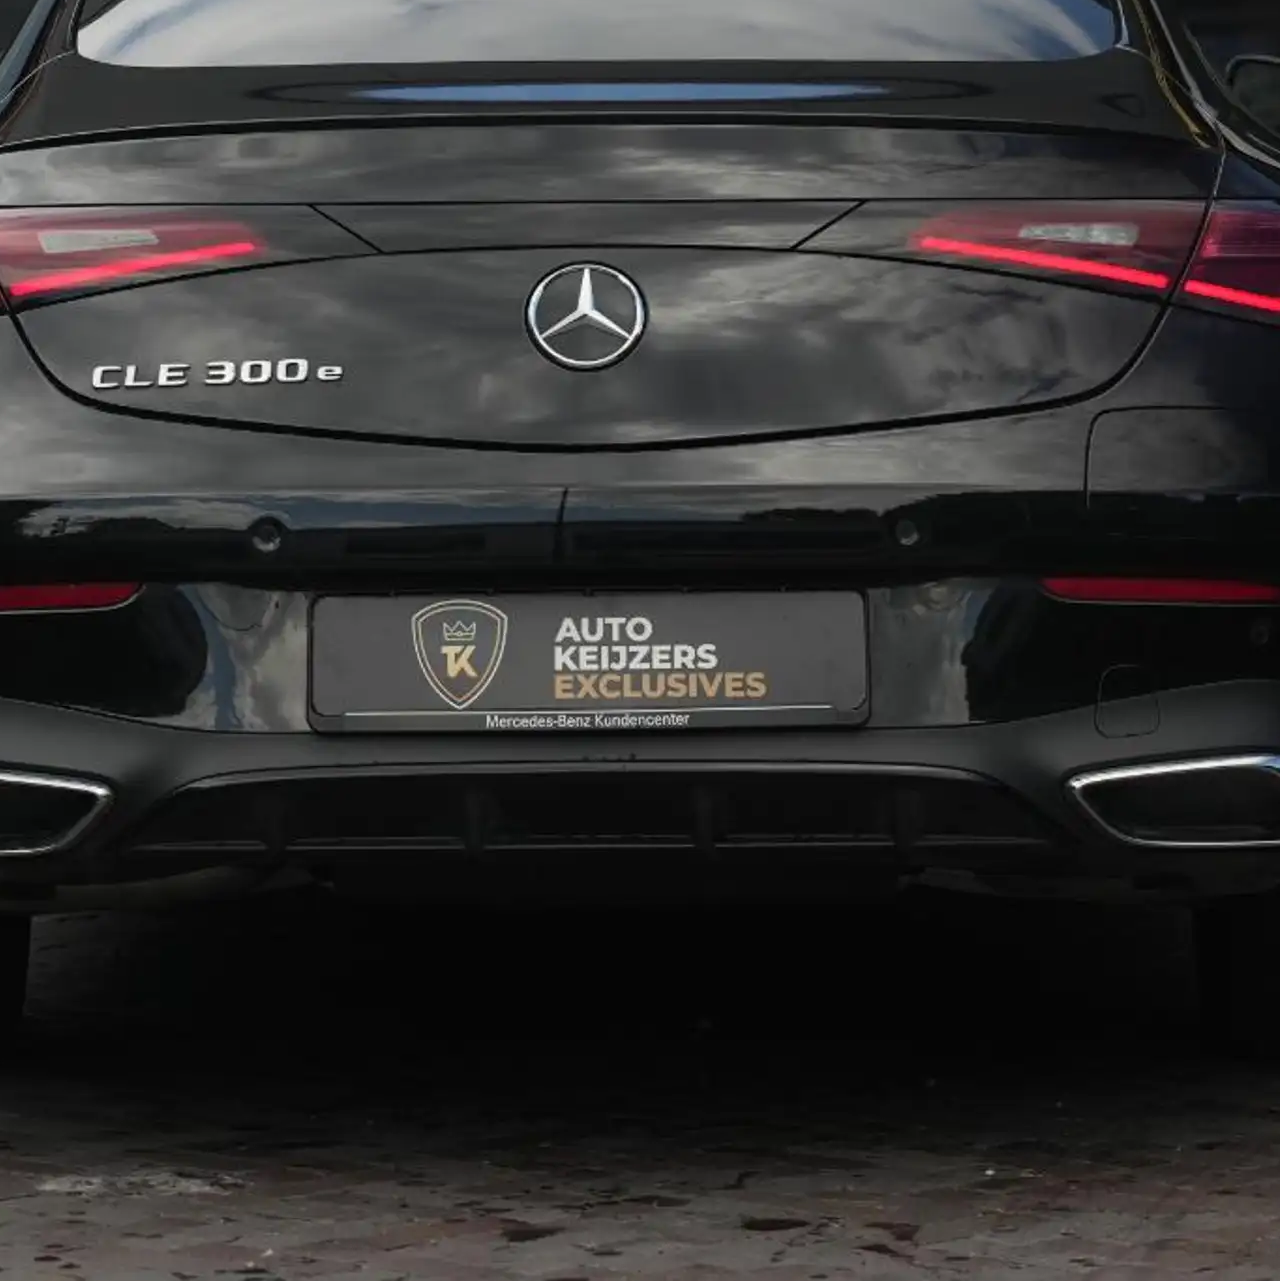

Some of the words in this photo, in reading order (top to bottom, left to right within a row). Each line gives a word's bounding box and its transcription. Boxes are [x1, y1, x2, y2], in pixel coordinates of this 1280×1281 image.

[91, 363, 191, 389] CLE
[555, 617, 654, 643] AUTO
[554, 643, 719, 671] KEIJZERS
[554, 671, 768, 699] EXCLUSIVES
[485, 714, 591, 729] Mercedes-Benz
[594, 713, 691, 728] Kundencenter
